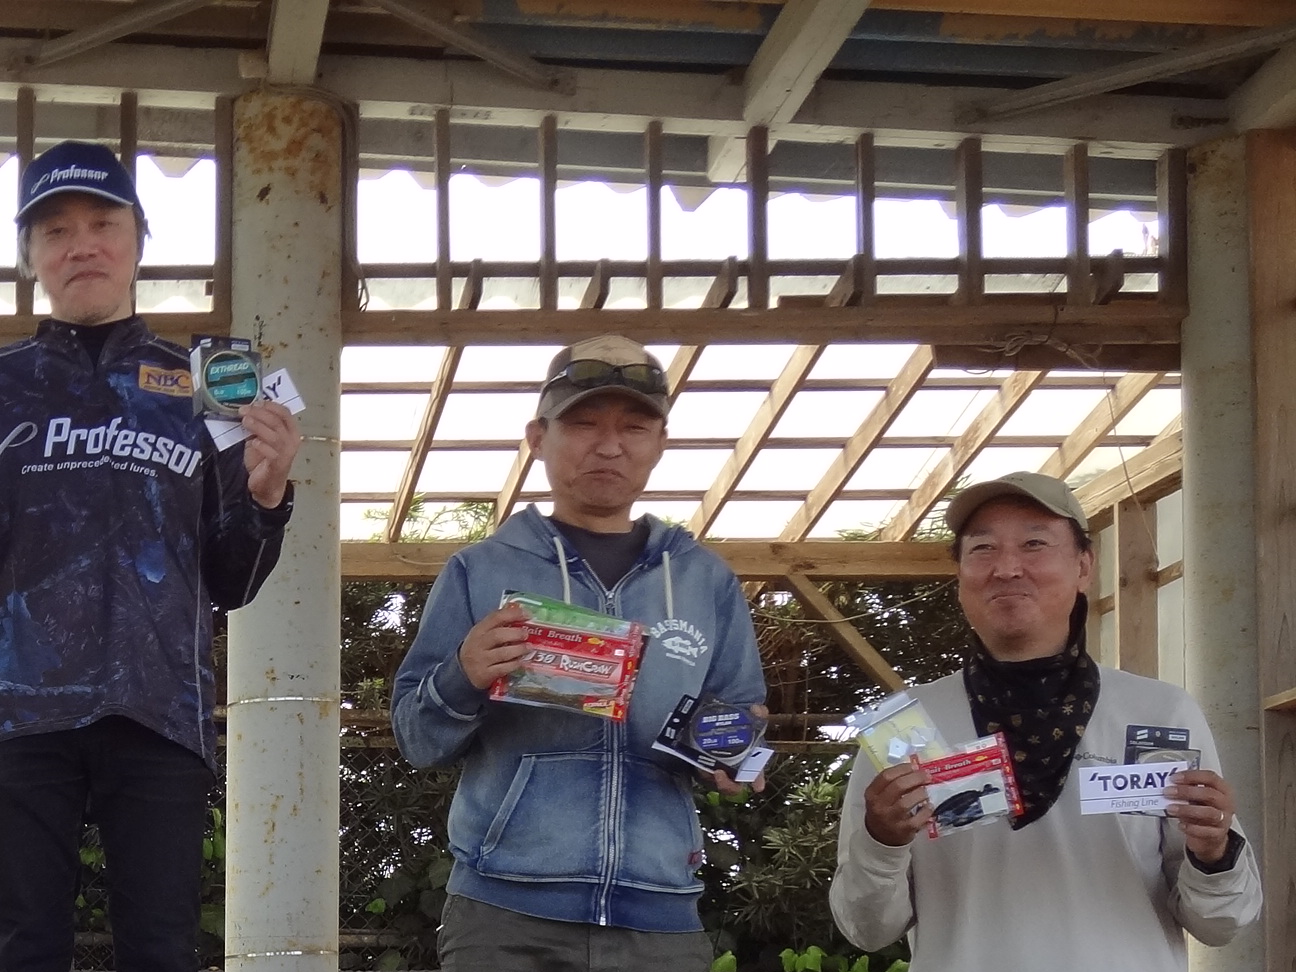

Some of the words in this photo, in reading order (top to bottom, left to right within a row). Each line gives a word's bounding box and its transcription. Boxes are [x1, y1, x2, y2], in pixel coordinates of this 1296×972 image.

[50, 164, 109, 184] Professor
[210, 362, 250, 376] EXTHREAD
[145, 371, 191, 390] NBC
[43, 416, 203, 478] Professor
[21, 463, 54, 475] Create
[547, 630, 583, 644] Breath
[1083, 751, 1117, 764] Columbia
[1110, 799, 1139, 809] Fishing
[1141, 799, 1159, 807] Line
